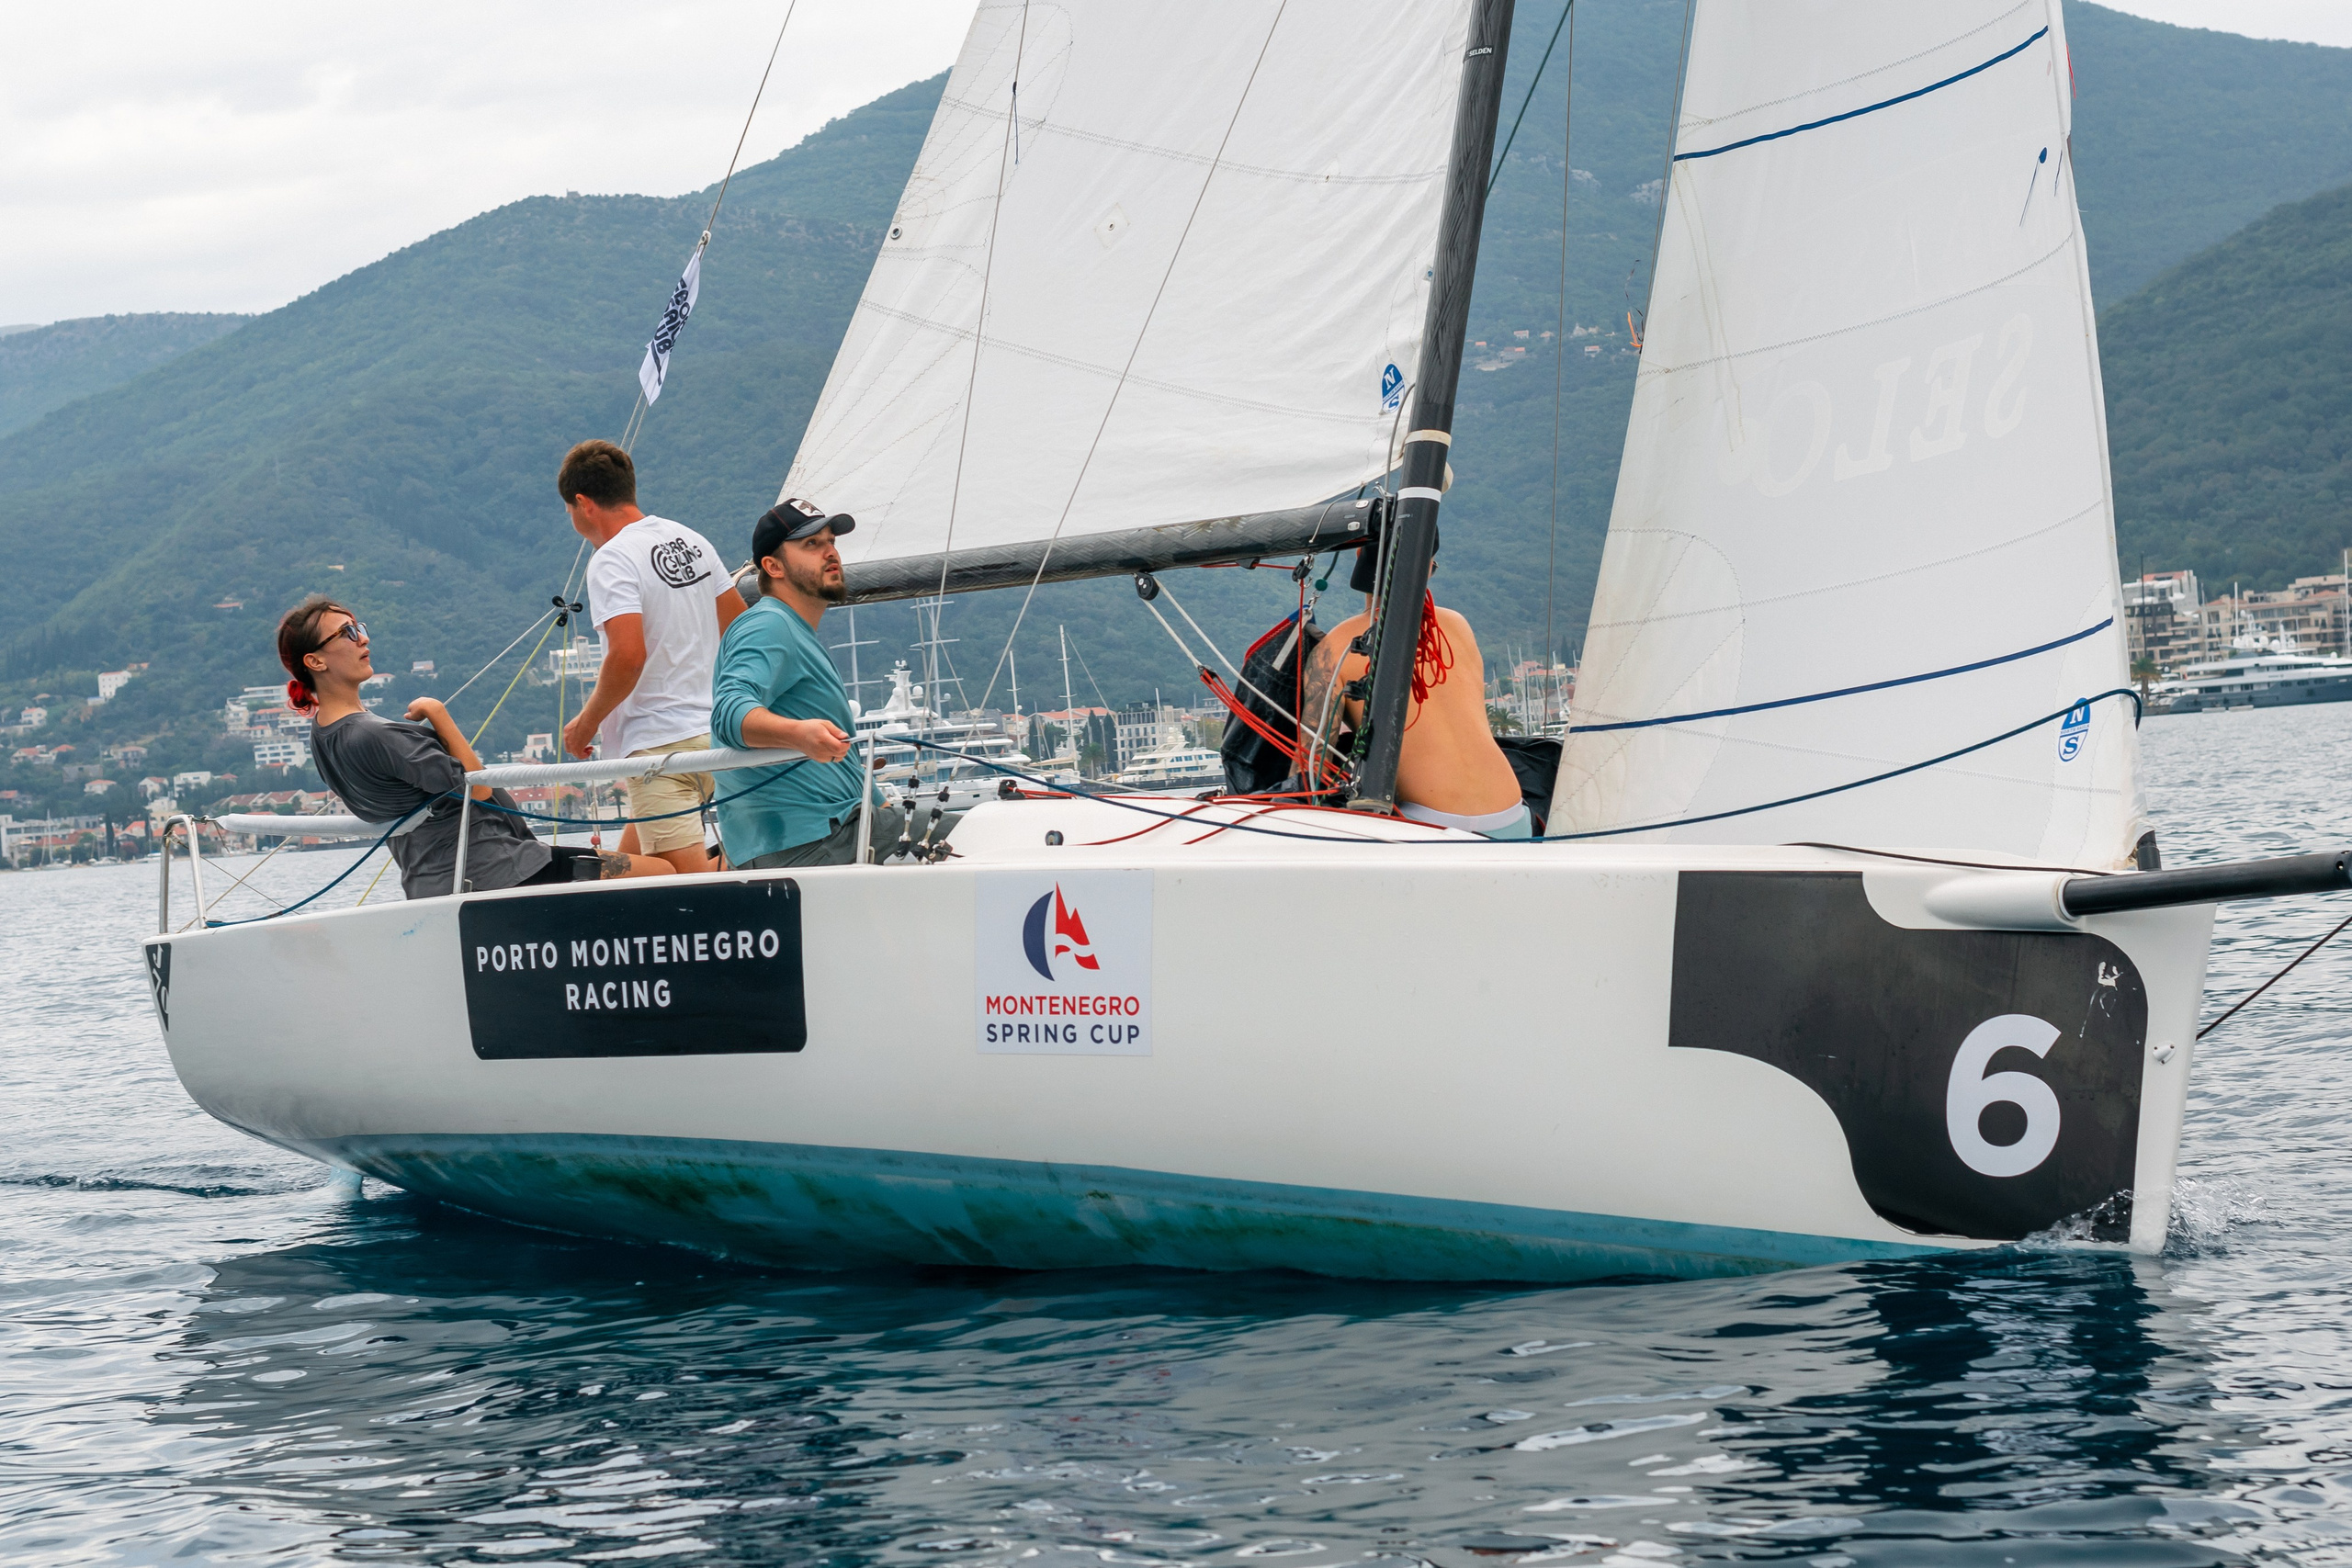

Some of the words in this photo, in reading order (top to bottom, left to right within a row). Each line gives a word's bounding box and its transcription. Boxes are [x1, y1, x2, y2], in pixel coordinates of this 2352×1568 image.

[2069, 705, 2086, 725] N
[2063, 735, 2080, 756] S
[476, 942, 559, 973] PORTO
[571, 929, 780, 967] MONTENEGRO
[566, 979, 672, 1011] RACING
[986, 995, 1140, 1017] MONTENEGRO
[986, 1023, 1077, 1044] SPRING
[1090, 1023, 1140, 1044] CUP
[1946, 1013, 2062, 1178] 6
